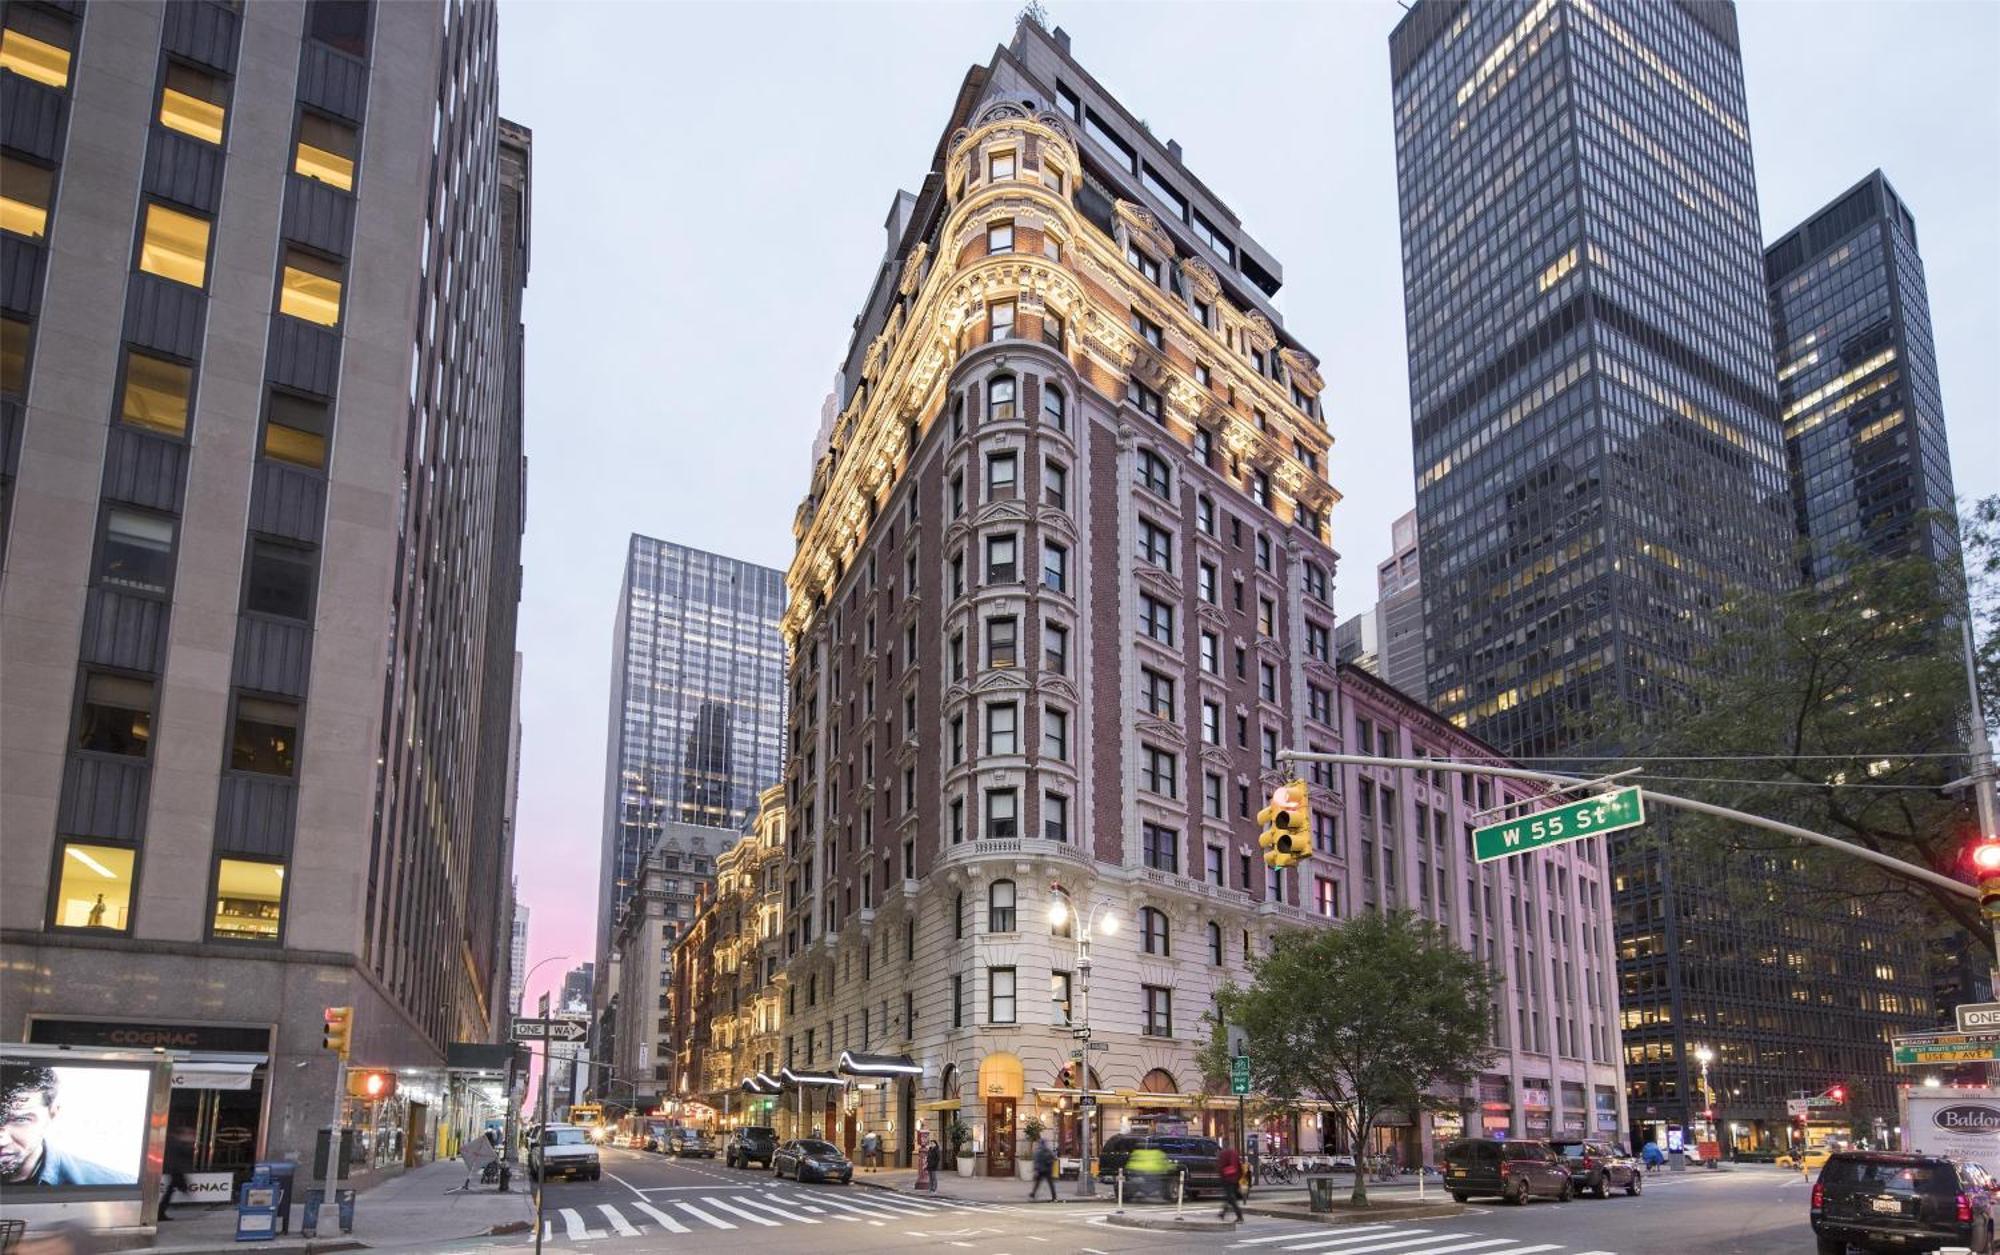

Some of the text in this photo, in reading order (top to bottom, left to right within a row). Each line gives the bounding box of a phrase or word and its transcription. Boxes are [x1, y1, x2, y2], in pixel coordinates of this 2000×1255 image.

[1502, 806, 1606, 848] W 55 St
[1968, 1012, 2000, 1024] ONE
[519, 1025, 578, 1035] ONE WAY
[110, 1030, 198, 1045] COGNAC
[1963, 1050, 1985, 1059] AVE
[1945, 1111, 2000, 1127] Baldor
